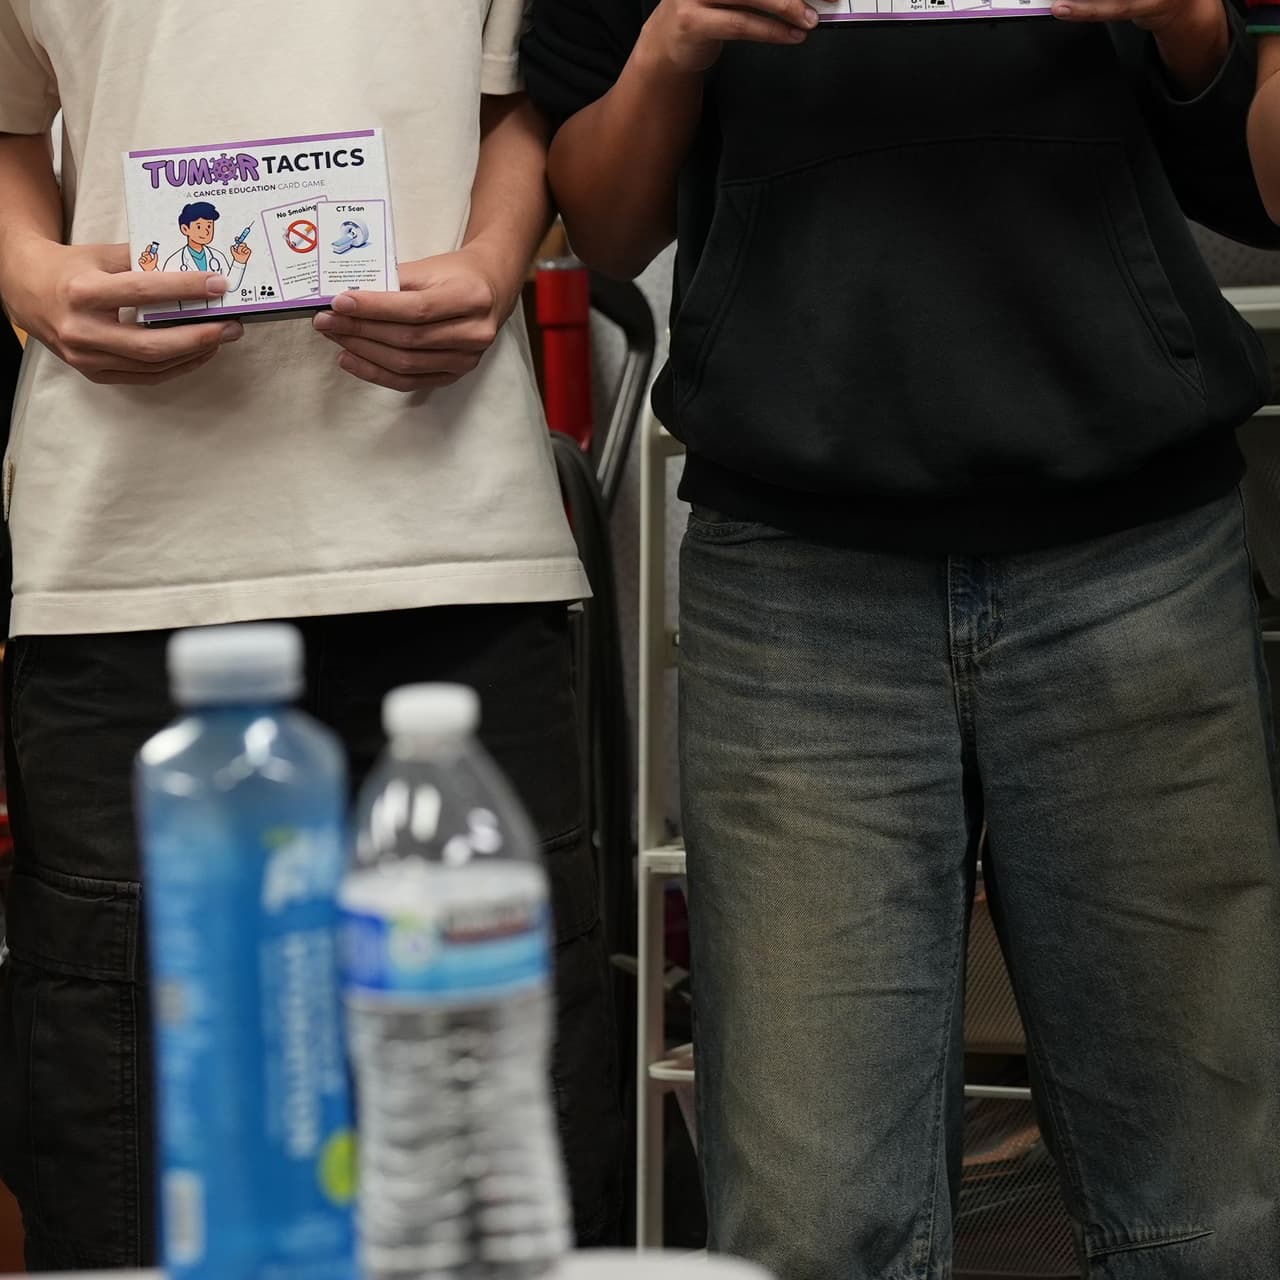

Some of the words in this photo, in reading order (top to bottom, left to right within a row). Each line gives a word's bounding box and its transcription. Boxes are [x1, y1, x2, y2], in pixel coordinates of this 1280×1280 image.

[142, 153, 259, 189] TUMOR
[262, 148, 365, 174] TACTICS
[194, 188, 227, 199] CANCER
[228, 183, 276, 195] EDUCATION
[277, 181, 301, 191] CARD
[301, 179, 325, 188] GAME
[287, 204, 317, 217] Smoking
